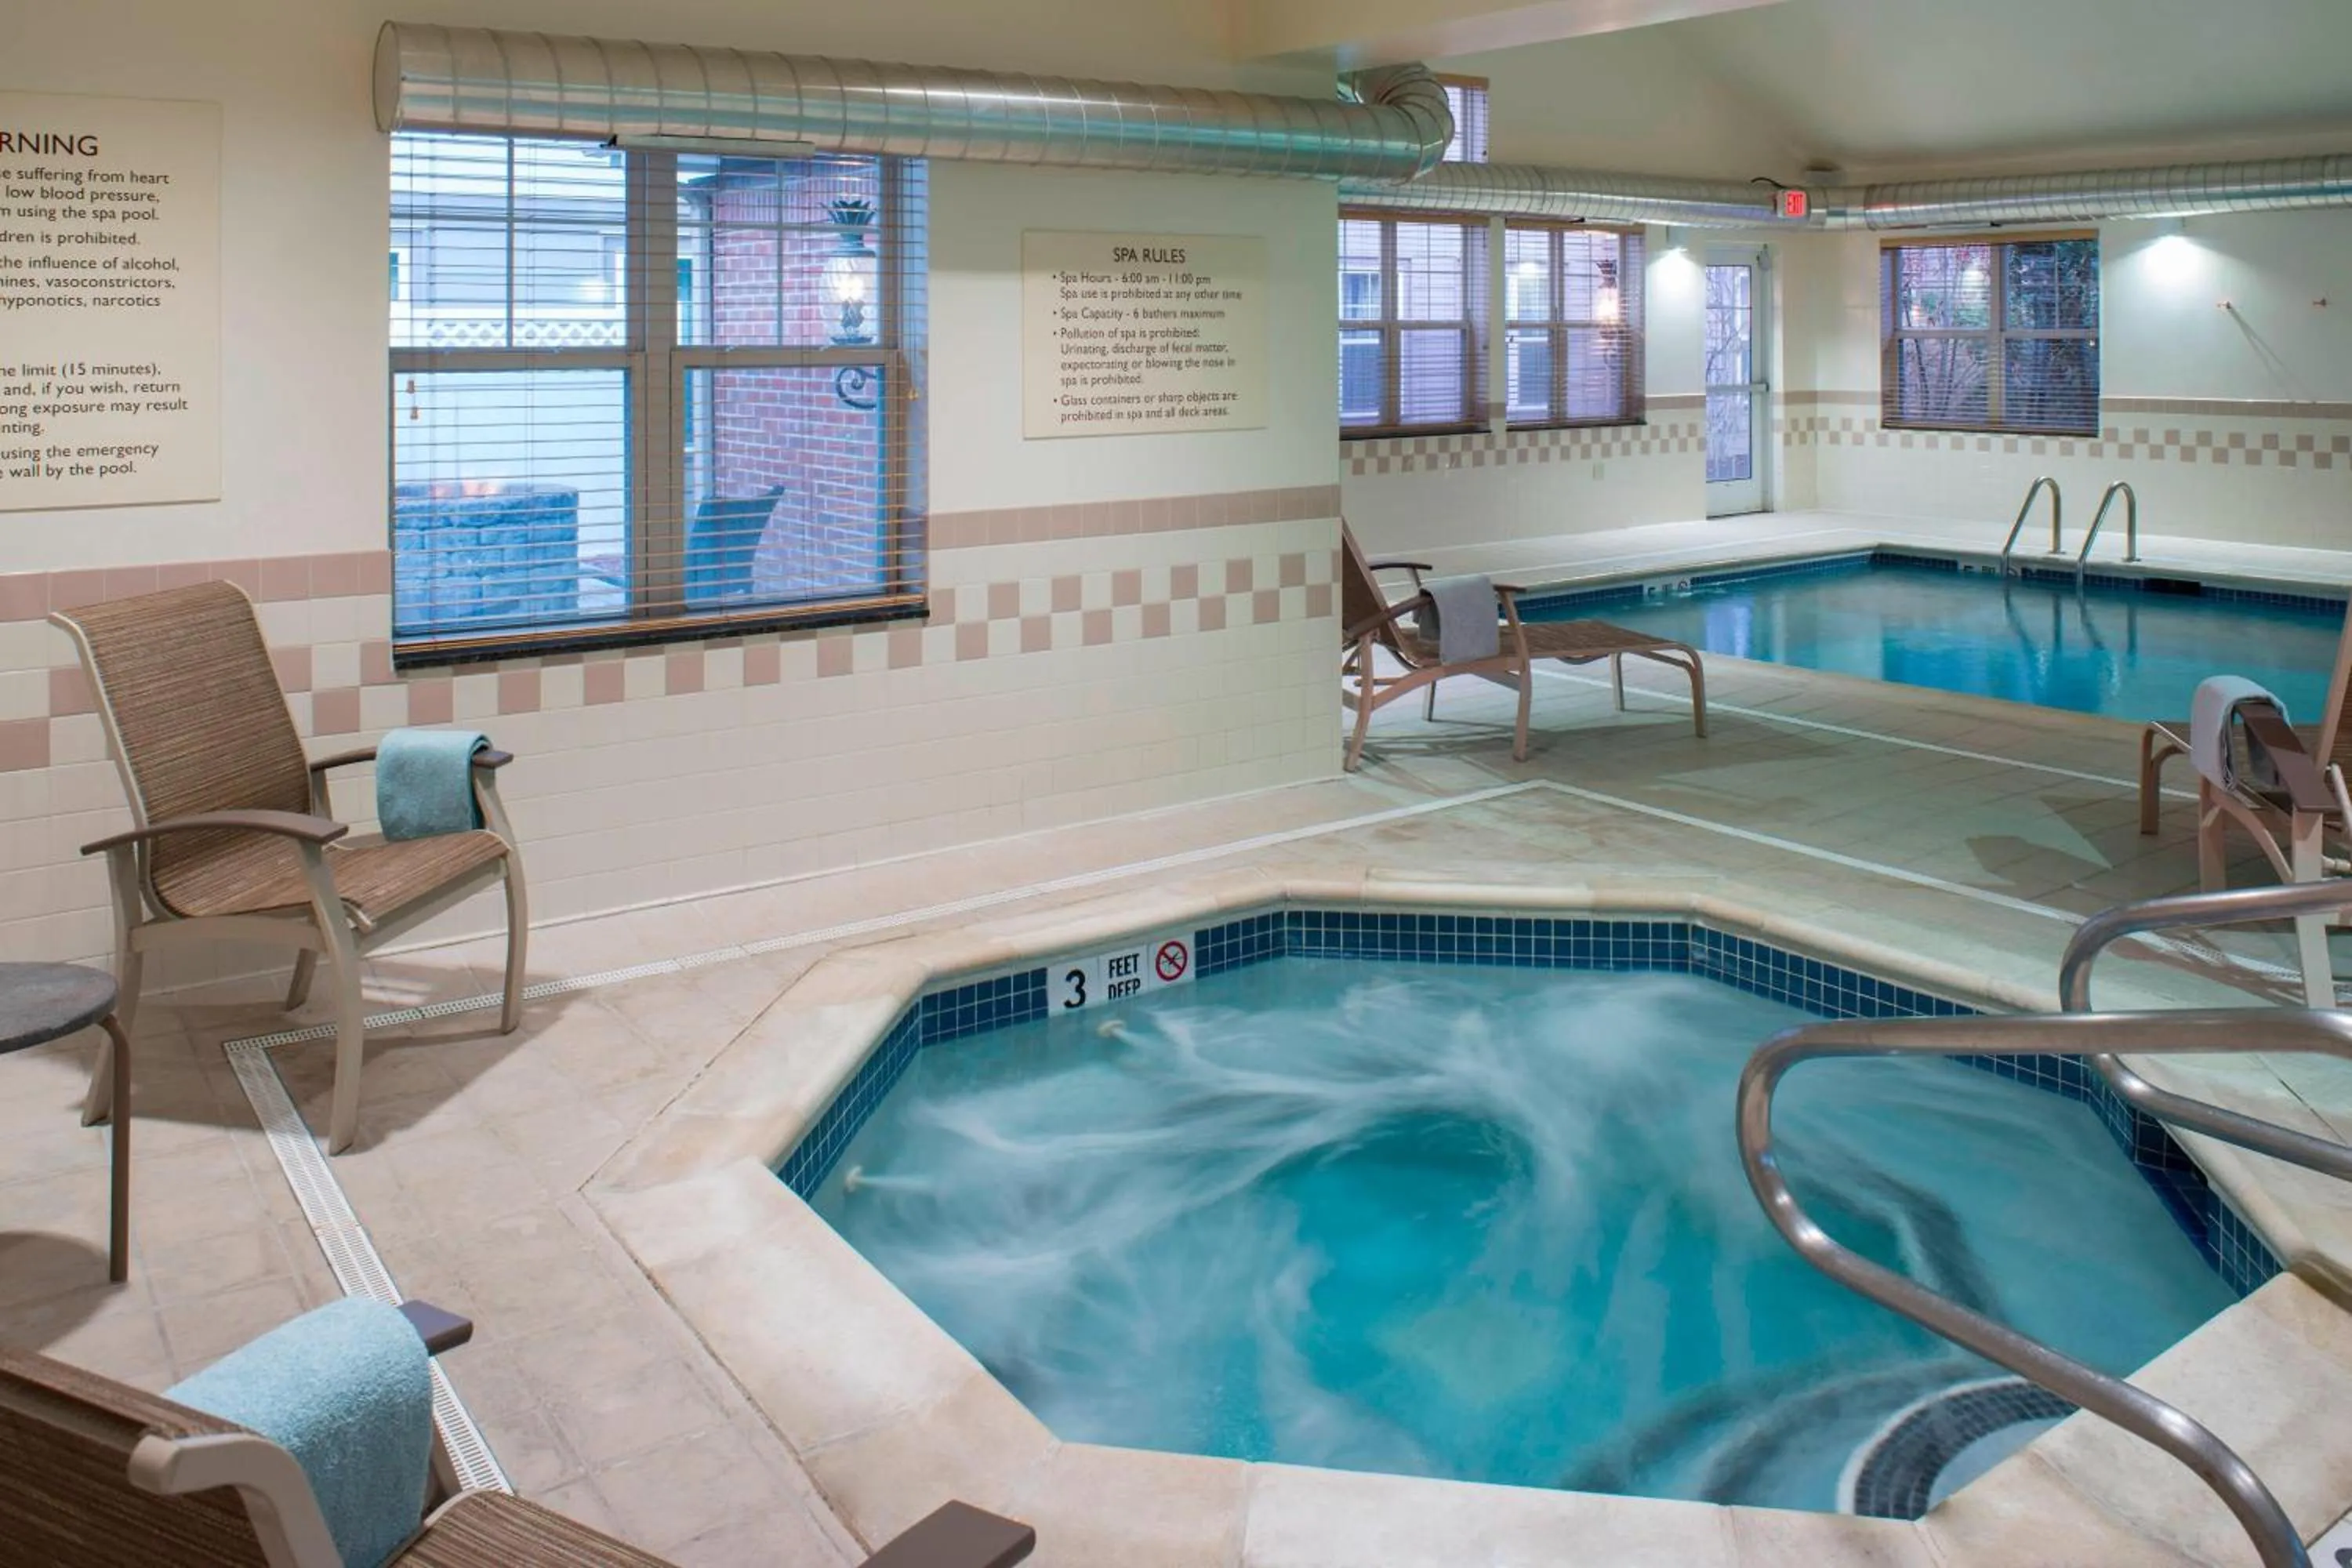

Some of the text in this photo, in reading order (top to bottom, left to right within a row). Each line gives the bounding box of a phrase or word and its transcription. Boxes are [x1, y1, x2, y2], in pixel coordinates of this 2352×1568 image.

[0, 132, 98, 156] RNING
[0, 167, 169, 186] e suffering from heart
[5, 185, 160, 204] low blood pressure,
[17, 205, 56, 221] using
[62, 205, 86, 219] the
[92, 208, 116, 223] spa
[122, 209, 159, 223] pool.
[41, 231, 52, 244] is
[57, 232, 140, 246] prohibited.
[1113, 247, 1185, 263] SPA RULES
[28, 256, 97, 269] influence
[103, 256, 118, 269] of
[122, 257, 180, 272] alcohol,
[1059, 270, 1077, 285] Spa
[1081, 272, 1112, 283] Hours
[1196, 276, 1211, 287] pm
[93, 295, 161, 307] narcotics
[1060, 286, 1078, 301] Spa
[1081, 290, 1098, 299] use
[1100, 289, 1108, 299] is
[1111, 288, 1161, 301] prohibited
[1176, 291, 1191, 302] any
[1194, 289, 1219, 299] other
[1061, 307, 1078, 321] Spa
[1081, 307, 1123, 321] Capacity
[1133, 308, 1139, 318] 6
[1143, 308, 1177, 318] bathers
[1180, 310, 1225, 318] maximum
[1061, 327, 1105, 339] Pollution
[1108, 327, 1118, 338] of
[1120, 329, 1136, 341] spa
[1139, 328, 1147, 338] is
[1112, 343, 1156, 356] discharge
[1160, 343, 1169, 353] of
[22, 363, 56, 376] limit
[62, 363, 85, 378] (15
[1061, 357, 1236, 372] expectorating or blowing the nose in
[1061, 376, 1077, 388] spa
[1080, 375, 1088, 386] is
[42, 382, 52, 394] if
[56, 384, 84, 398] you
[133, 382, 180, 394] return
[1061, 390, 1239, 406] Glass containers or sharp objects are
[32, 402, 105, 416] exposure
[111, 401, 141, 415] may
[146, 397, 189, 411] result
[1061, 408, 1112, 423] prohibited
[1115, 411, 1123, 419] in
[1127, 410, 1142, 422] spa
[1145, 407, 1163, 418] and
[1165, 406, 1174, 418] all
[1178, 405, 1200, 417] deck
[1, 444, 159, 462] using the emergency
[9, 463, 40, 477] wall
[46, 464, 64, 480] by
[70, 463, 95, 476] the
[99, 461, 137, 477] pool.
[1109, 953, 1140, 979] FEET
[1063, 969, 1086, 1008] 3
